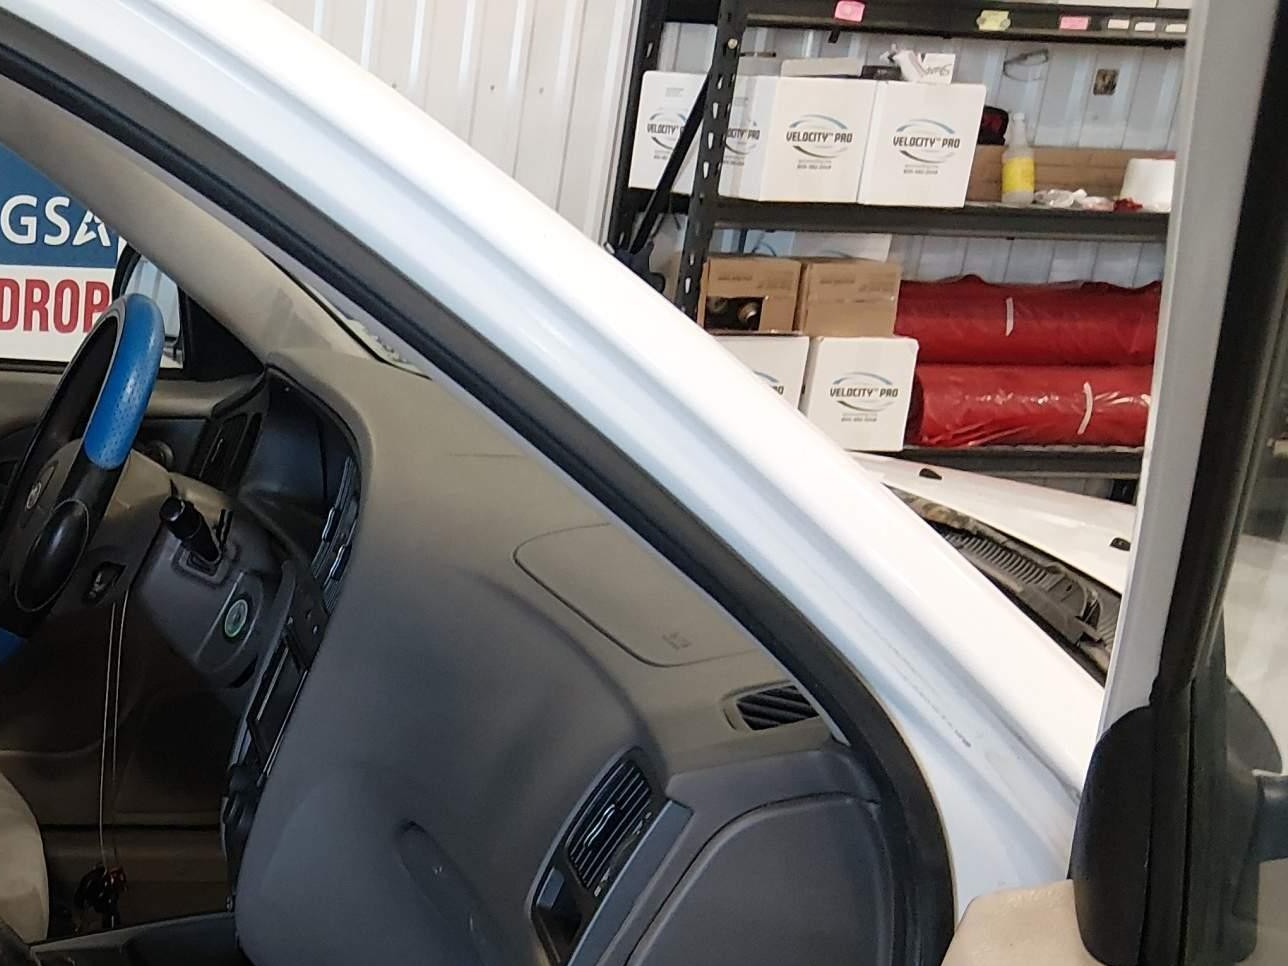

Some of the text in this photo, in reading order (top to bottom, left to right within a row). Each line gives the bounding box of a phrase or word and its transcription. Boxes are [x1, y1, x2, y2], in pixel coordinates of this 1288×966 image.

[786, 131, 853, 143] VELOCITY PRO
[893, 136, 961, 149] VELOCITY PRO
[0, 195, 111, 247] GSA
[830, 387, 899, 398] VELOCITY PRO
